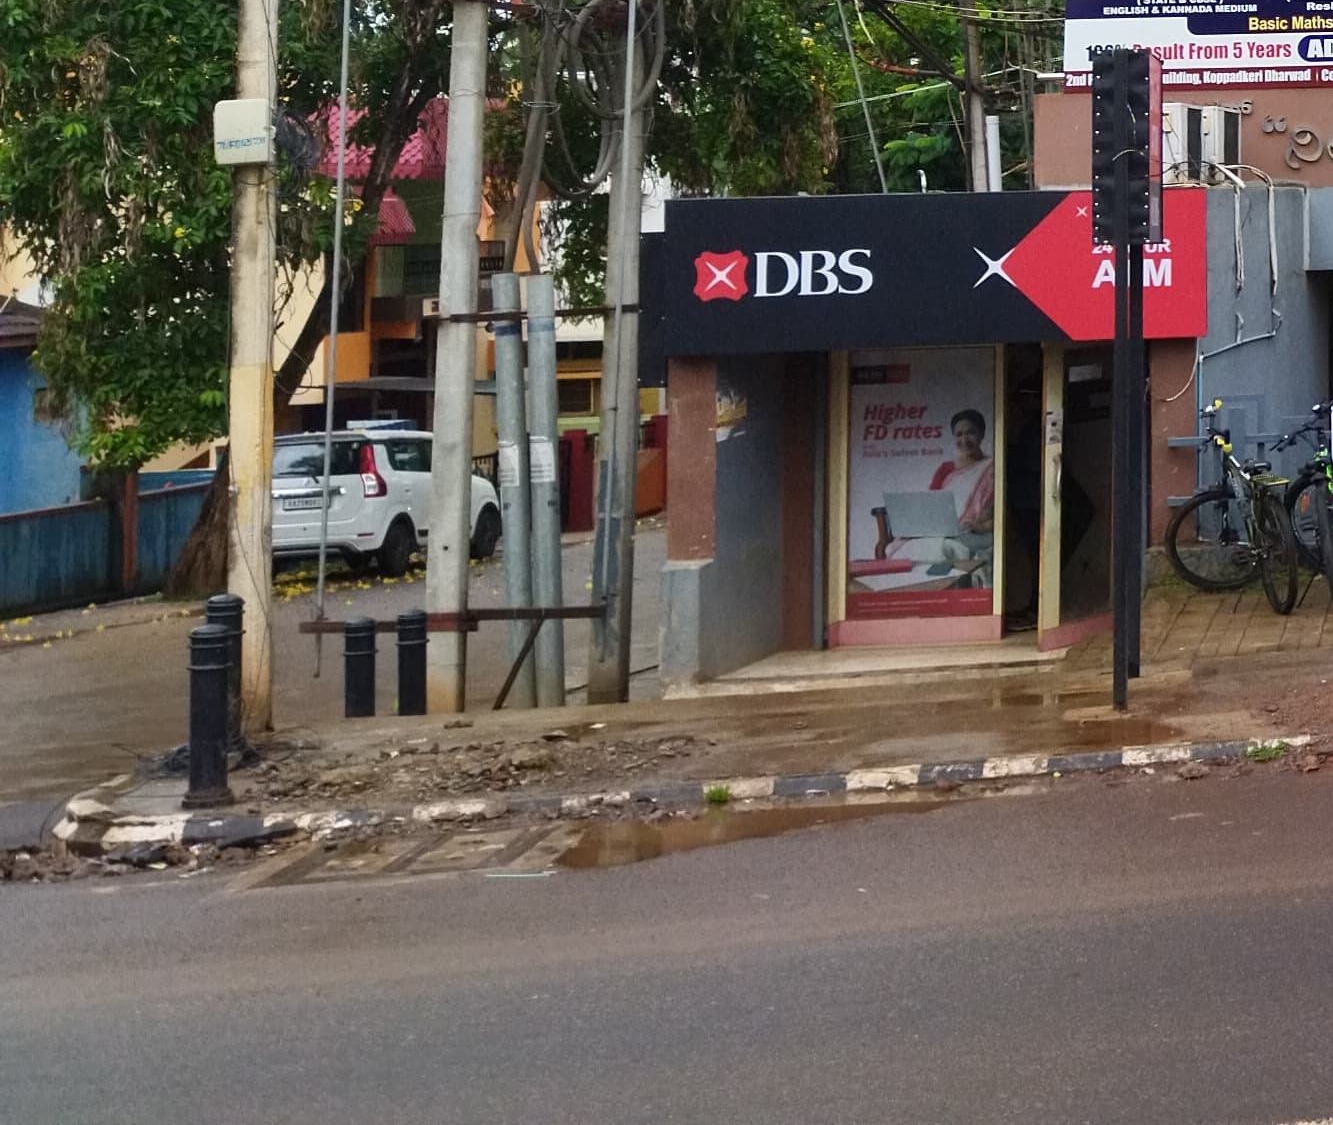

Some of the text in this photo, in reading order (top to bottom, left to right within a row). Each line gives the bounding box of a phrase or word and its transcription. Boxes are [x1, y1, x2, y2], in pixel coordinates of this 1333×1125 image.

[1103, 4, 1257, 15] ENGLISH & KANNADA MEDIUM
[1249, 16, 1288, 30] Basic
[1292, 18, 1333, 29] Maths
[1189, 42, 1291, 59] From 5 Years
[1066, 75, 1085, 86] 2nd
[1265, 68, 1311, 82] Dharwad
[753, 249, 873, 297] DBS
[1091, 259, 1172, 288] AM
[864, 404, 928, 425] Higher
[863, 424, 943, 441] FD rates
